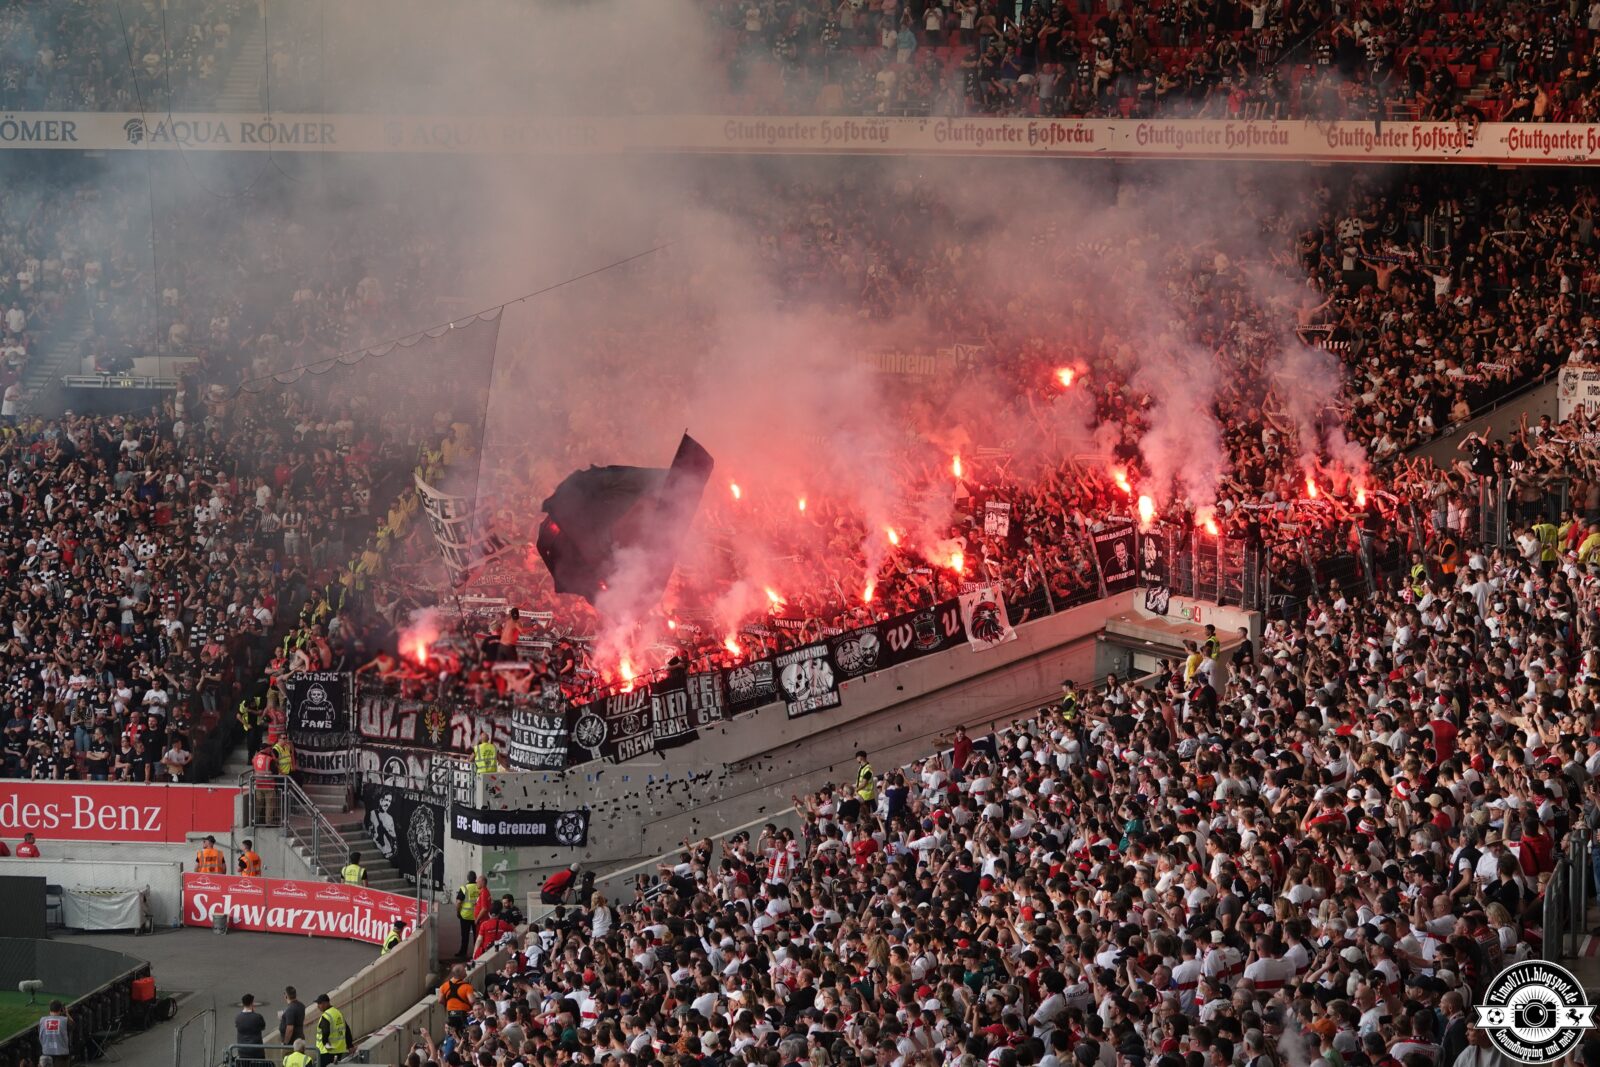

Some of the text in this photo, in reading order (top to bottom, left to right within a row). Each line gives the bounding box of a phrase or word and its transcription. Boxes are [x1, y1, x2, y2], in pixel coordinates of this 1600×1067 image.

[151, 117, 337, 146] AQUA RÖMER
[724, 119, 818, 145] Stuttgarter
[934, 121, 1095, 147] Stuttgarter Hofbräu
[1136, 123, 1289, 149] Stuttgarter Hofbräu
[1326, 126, 1409, 152] Stuttgarter
[1508, 127, 1585, 155] Stuttgarter
[1195, 606, 1200, 621] 4
[775, 644, 829, 668] COMMANDO
[296, 671, 339, 682] EXTREME
[606, 687, 646, 716] FULDA
[651, 691, 688, 721] RIED
[788, 690, 839, 717] GIESSEN
[301, 719, 333, 729] FANS
[512, 708, 563, 730] ULTRAS
[612, 714, 648, 735] 3 6
[653, 715, 690, 738] GEBIET
[514, 728, 556, 748] NEVER
[617, 731, 655, 761] CREW
[0, 794, 162, 832] des-Benz
[456, 814, 468, 829] EFC
[471, 820, 496, 835] Ohne
[498, 821, 547, 835] Grenzen
